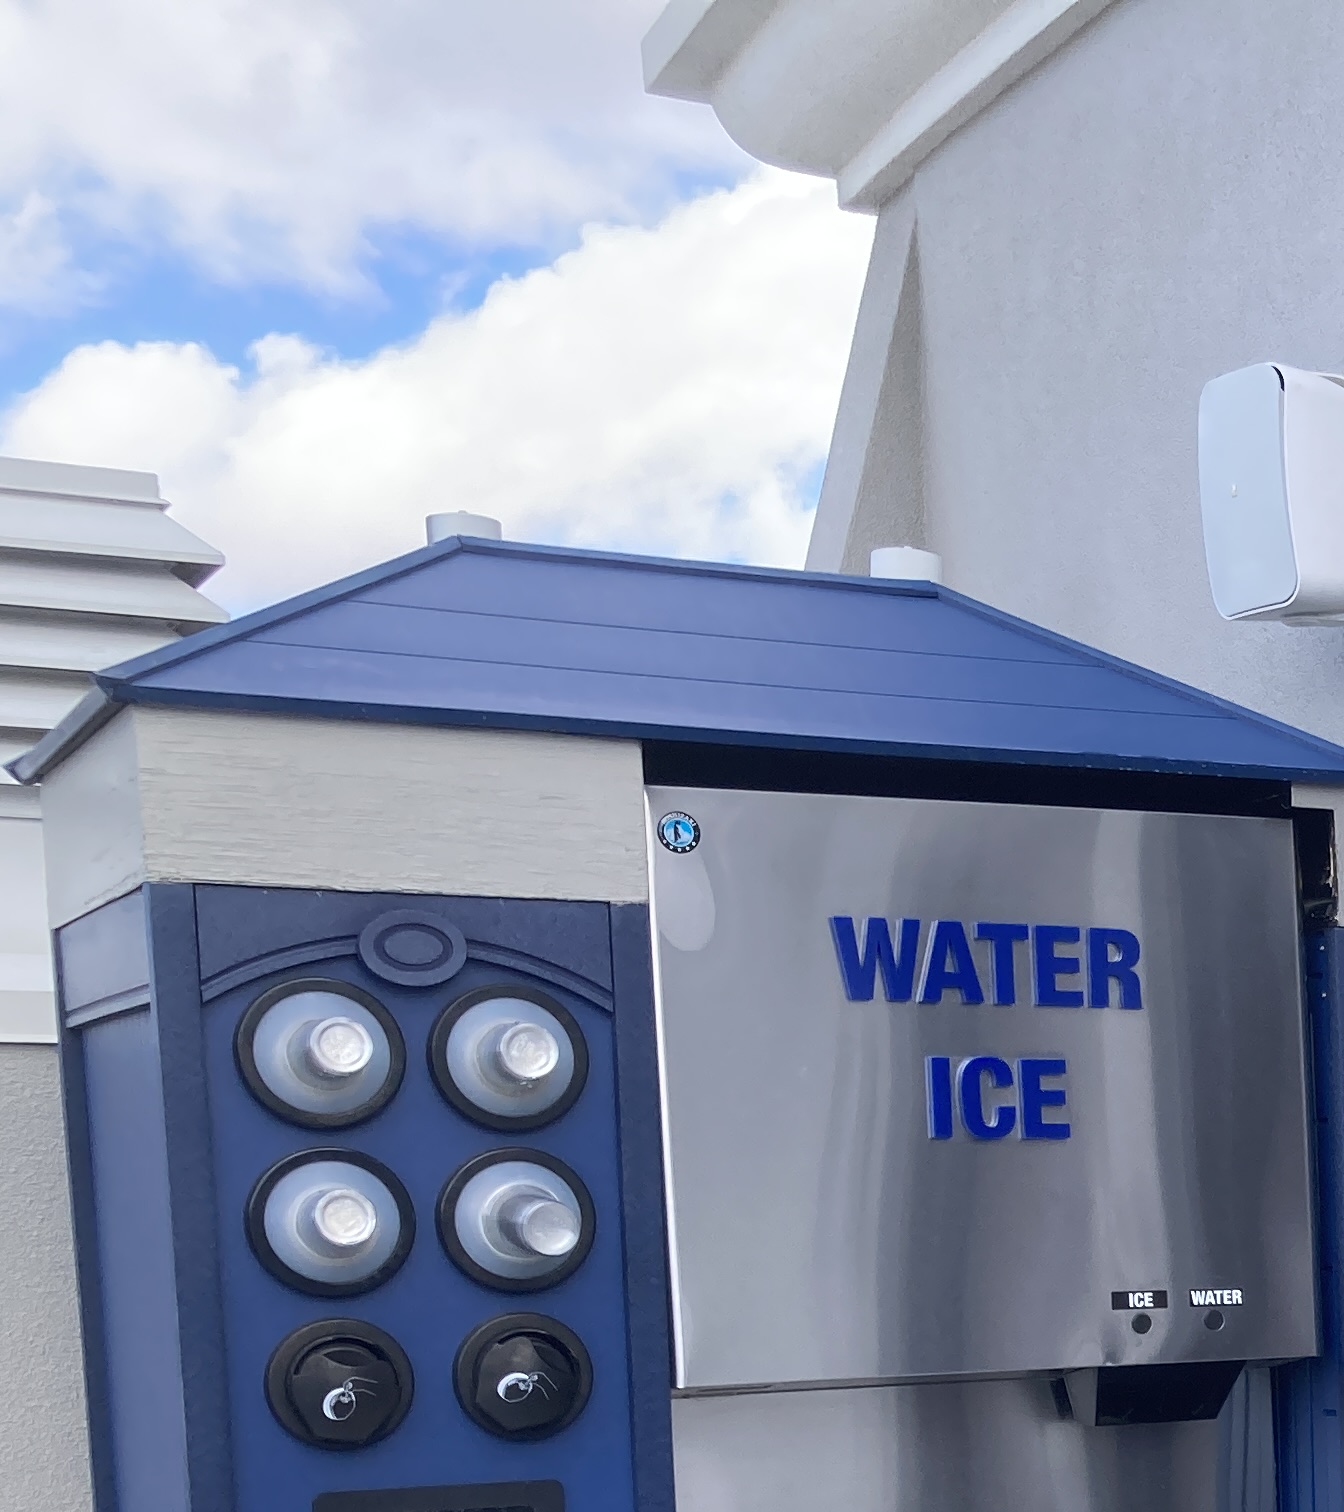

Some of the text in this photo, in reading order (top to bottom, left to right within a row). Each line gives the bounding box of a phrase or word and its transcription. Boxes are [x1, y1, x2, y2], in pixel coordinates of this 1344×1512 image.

[830, 916, 1143, 1010] WATER
[925, 1056, 1071, 1140] ICE
[1128, 1292, 1154, 1308] ICE
[1191, 1290, 1242, 1305] WATER
